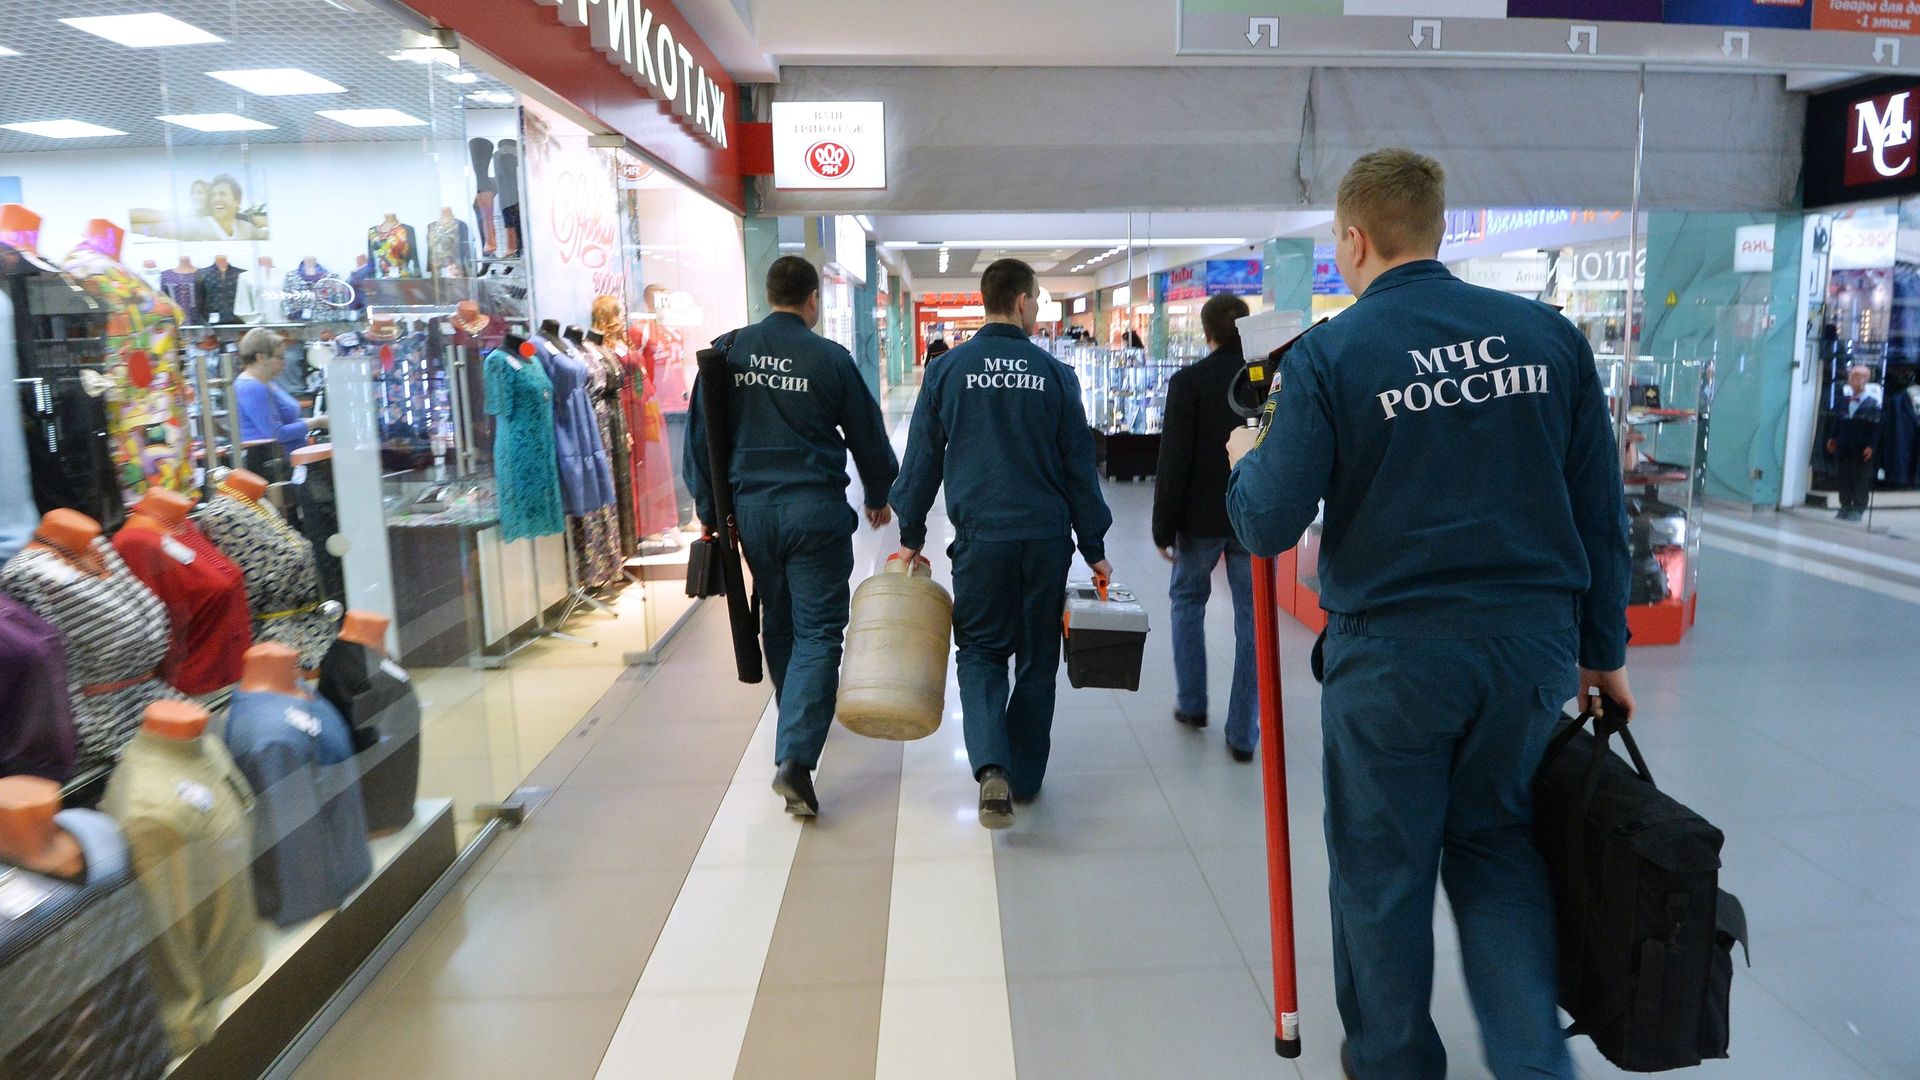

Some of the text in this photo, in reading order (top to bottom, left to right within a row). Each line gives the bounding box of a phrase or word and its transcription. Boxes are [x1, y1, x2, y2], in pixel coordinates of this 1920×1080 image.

[553, 0, 728, 149] ИКОТАЖ
[750, 354, 793, 373] МЧС
[983, 358, 1029, 372] МЧС
[1408, 335, 1510, 376] МЧС
[734, 371, 809, 393] РОССИИ
[966, 373, 1046, 392] РОССИИ
[1376, 364, 1550, 421] РОССИИ
